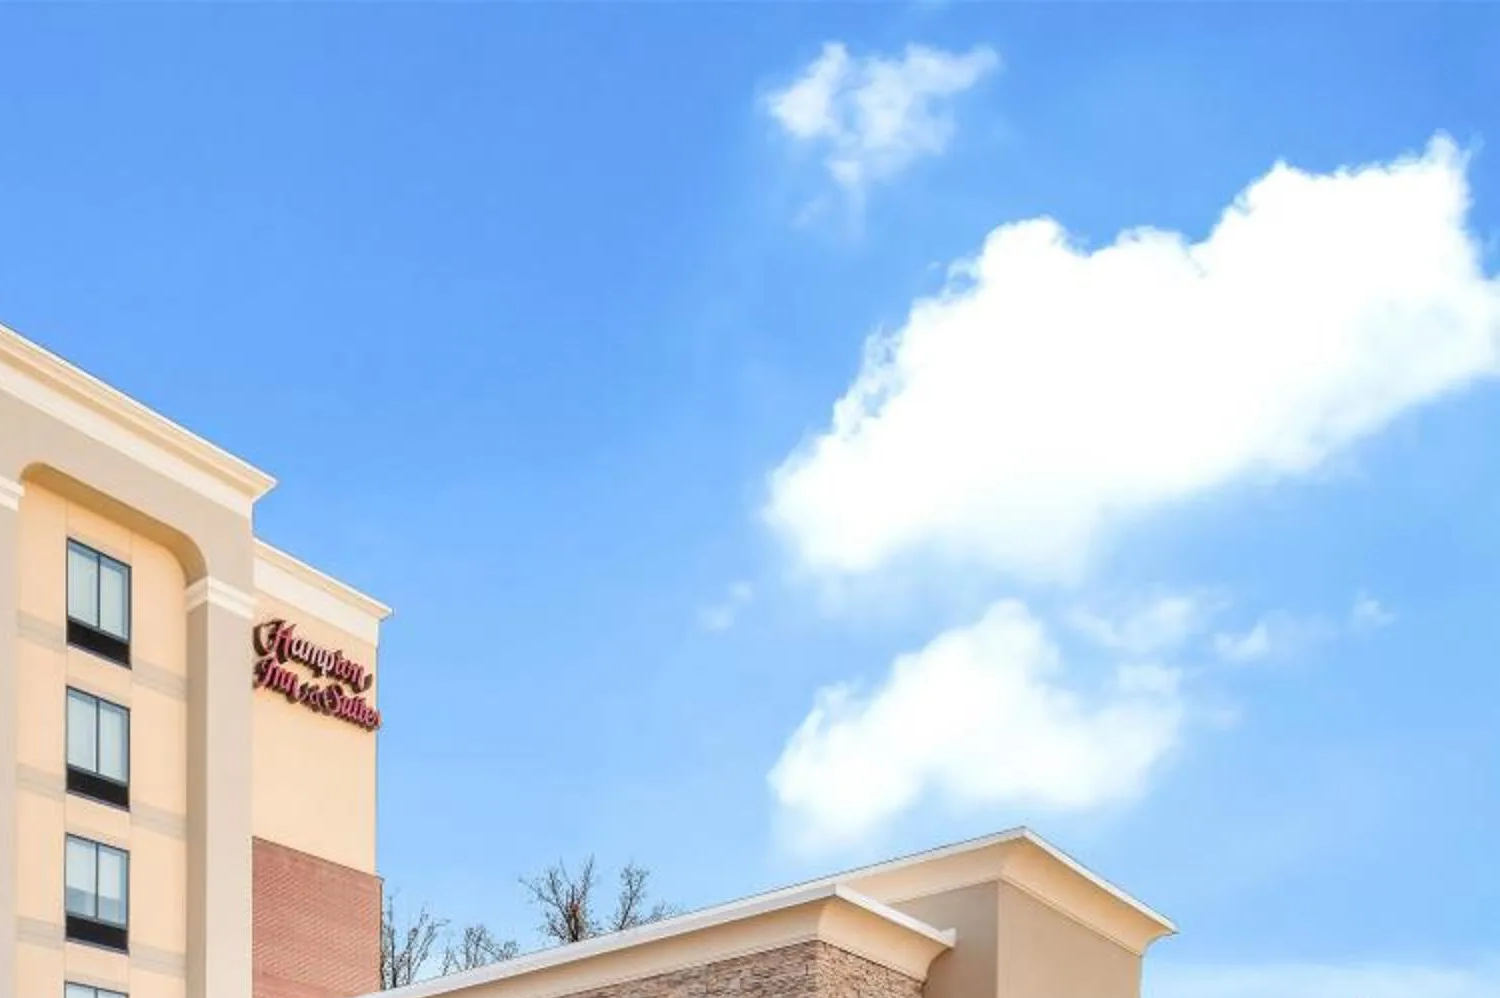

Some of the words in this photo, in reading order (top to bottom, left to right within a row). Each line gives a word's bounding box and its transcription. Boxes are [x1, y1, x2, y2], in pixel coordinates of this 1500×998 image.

[253, 619, 372, 694] Hampton
[253, 658, 300, 704] Inn
[320, 684, 381, 732] Suites
